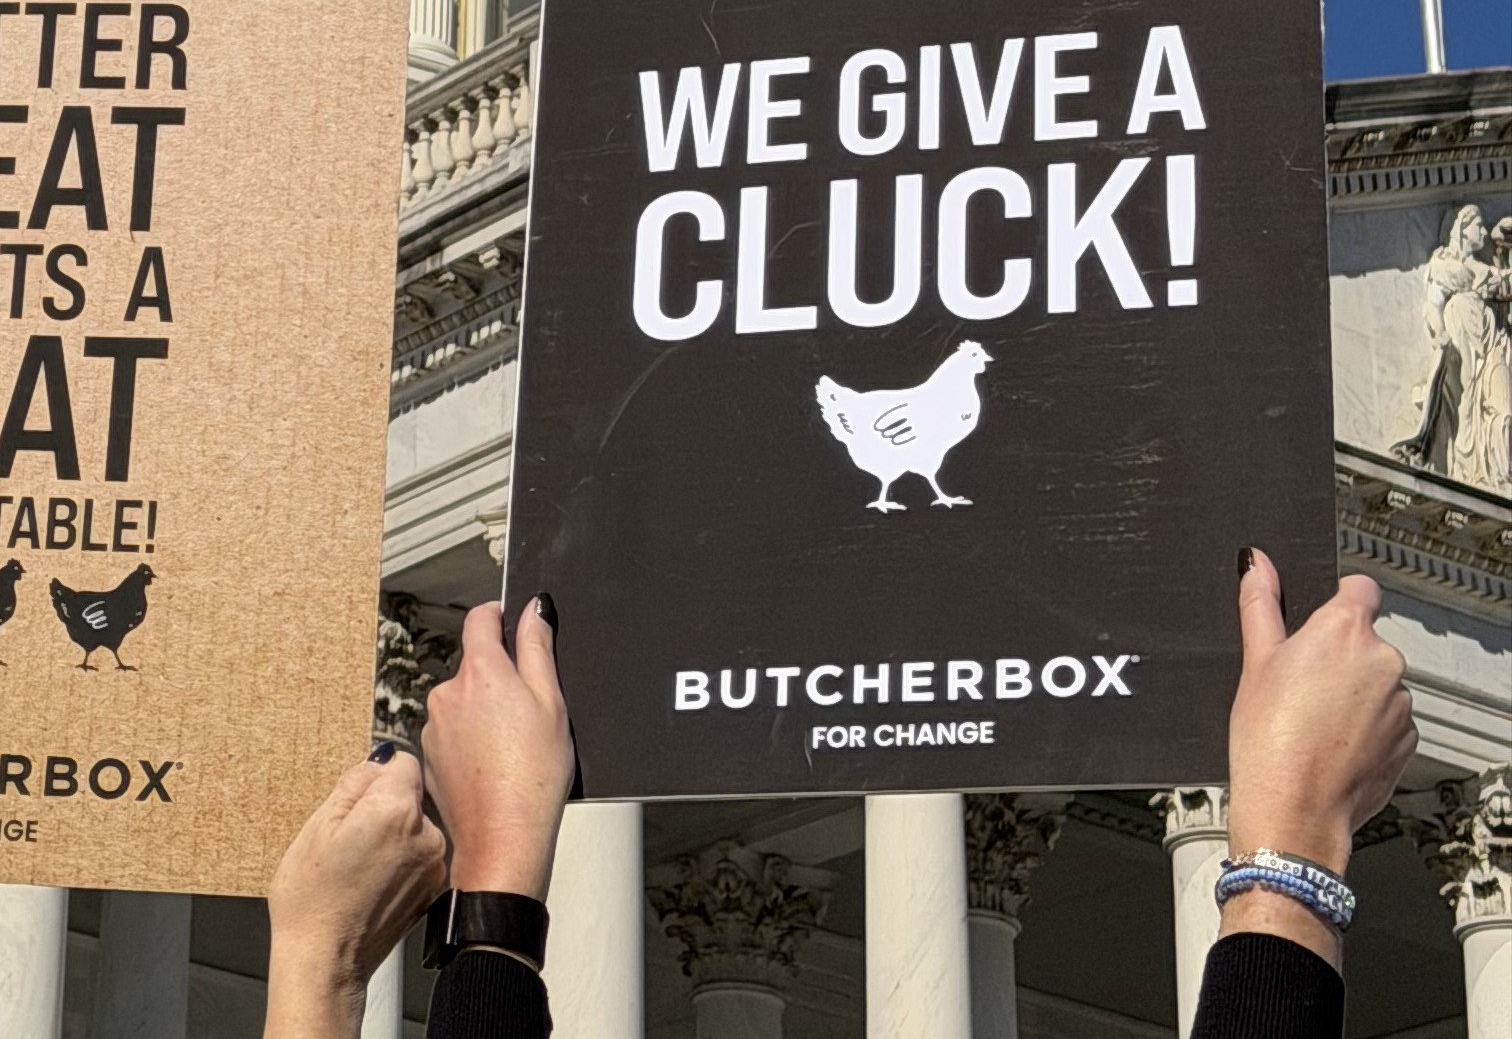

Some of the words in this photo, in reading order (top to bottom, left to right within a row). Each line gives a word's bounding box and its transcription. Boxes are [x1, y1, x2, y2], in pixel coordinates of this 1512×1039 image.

[638, 56, 811, 173] WE
[838, 31, 1098, 156] GIVE
[1126, 24, 1207, 135] A
[123, 246, 174, 323] A
[632, 154, 1198, 341] CLUCK!
[674, 654, 1132, 711] BUTCHERBOX
[812, 725, 867, 750] FOR
[873, 721, 995, 747] CHANGE
